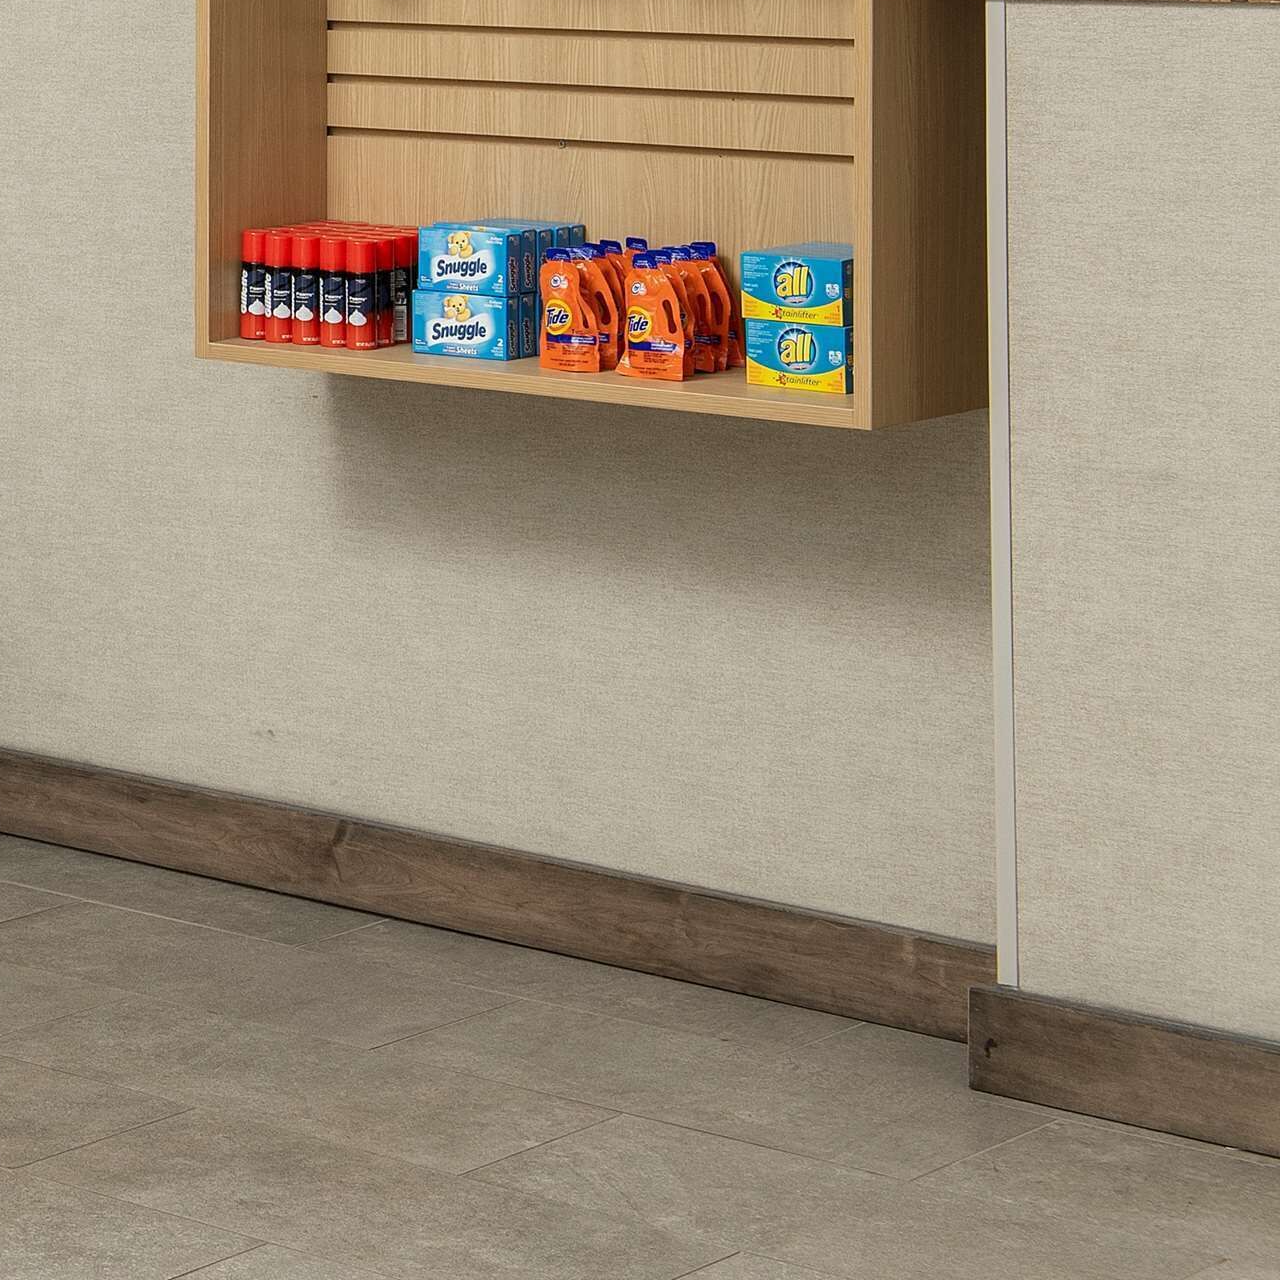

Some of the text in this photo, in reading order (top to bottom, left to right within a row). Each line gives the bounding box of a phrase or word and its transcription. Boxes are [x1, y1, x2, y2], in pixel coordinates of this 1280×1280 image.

[436, 256, 487, 279] Snuggle
[458, 282, 479, 293] Sheets
[497, 274, 504, 283] 2
[776, 266, 810, 297] all
[544, 307, 570, 328] Tide
[627, 315, 649, 333] Tide
[432, 320, 487, 342] Snuggle
[455, 345, 478, 356] Sheets
[497, 338, 503, 346] 2
[780, 333, 813, 364] all
